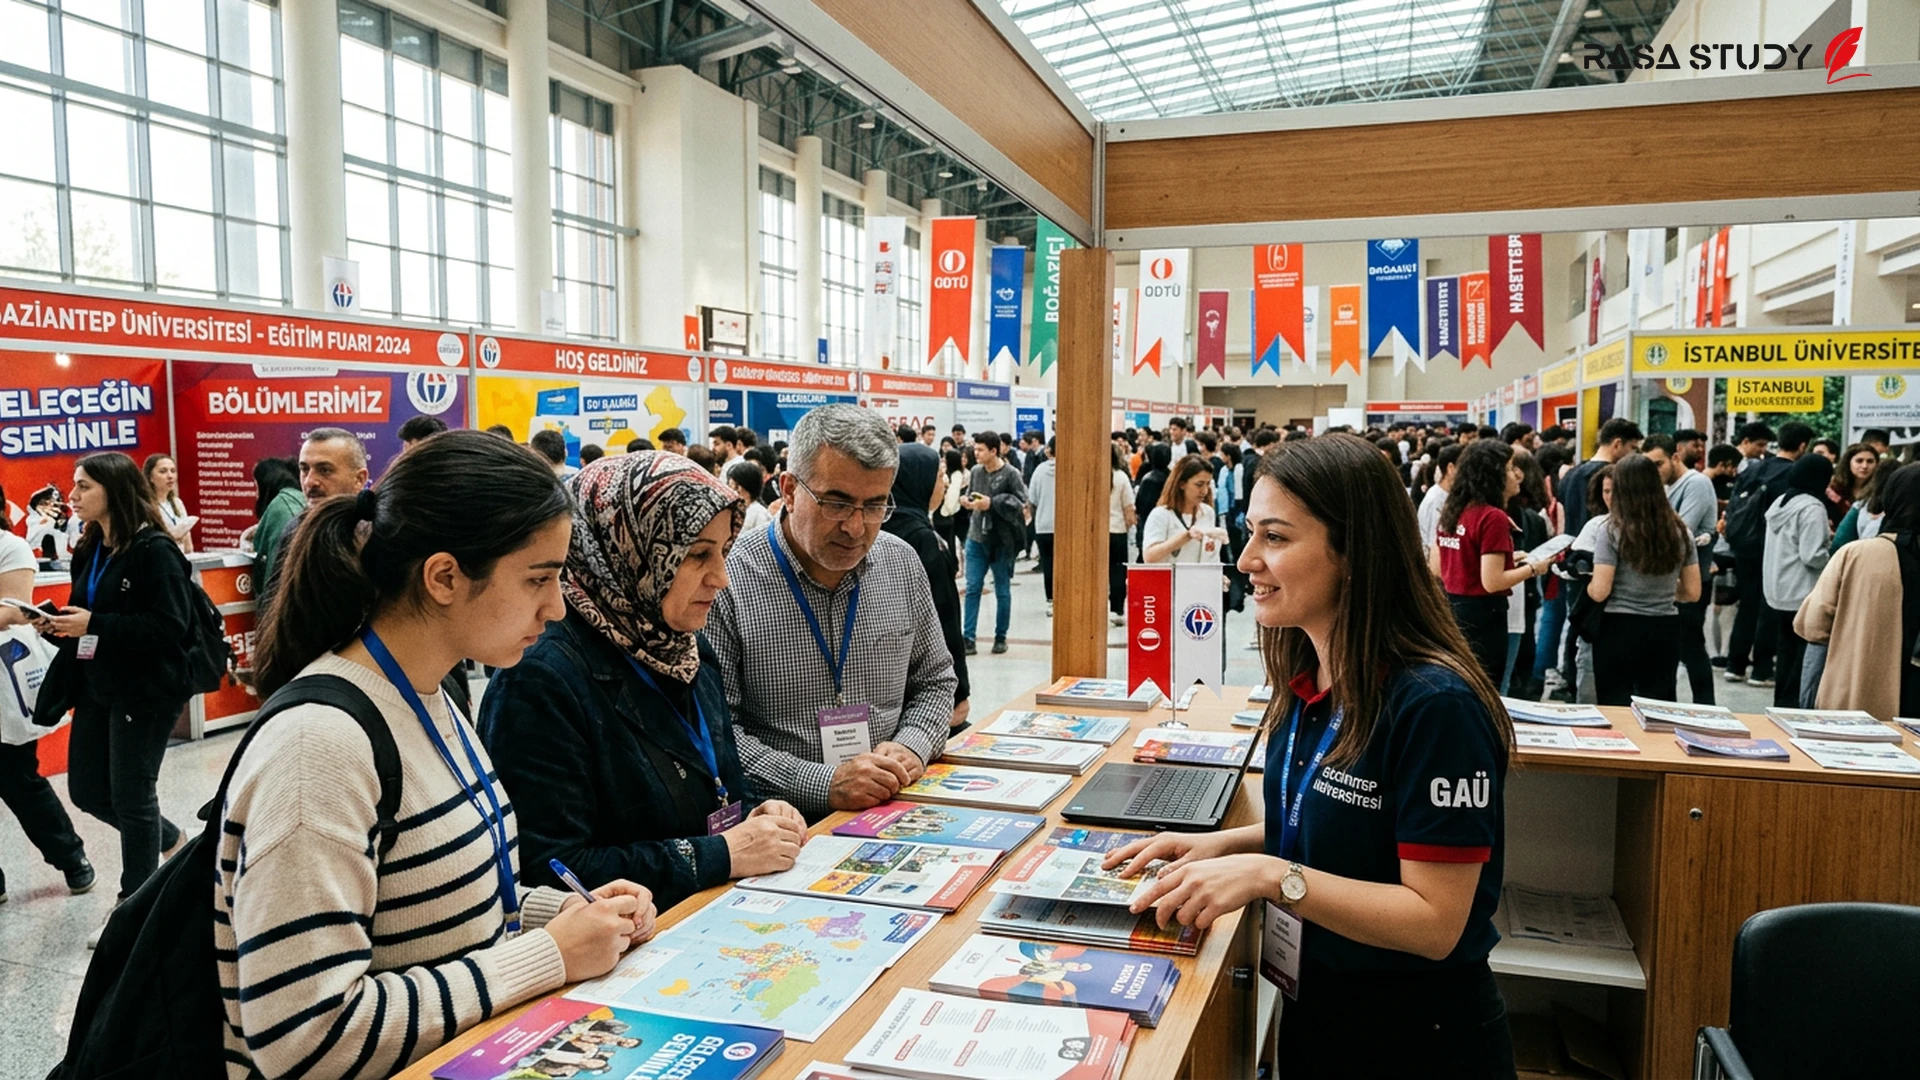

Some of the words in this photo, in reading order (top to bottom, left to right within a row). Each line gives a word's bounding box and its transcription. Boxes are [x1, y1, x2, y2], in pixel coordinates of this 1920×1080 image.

[1145, 285, 1181, 298] ODTÜ
[0, 300, 116, 332] AZİANTEP
[122, 308, 252, 343] ÜNİVERSİTESİ
[268, 323, 323, 349] EĞİTİM
[327, 331, 371, 352] FUARI
[375, 336, 411, 355] 2024
[555, 349, 584, 374] HOŞ
[588, 351, 648, 375] GELDİNİZ
[1684, 342, 1787, 363] İSTANBUL
[208, 385, 383, 415] BÖLÜMLERİMİZ
[1737, 378, 1815, 394] İSTANBUL
[1, 417, 137, 455] SENİNLE
[1430, 771, 1490, 808] GAÜ
